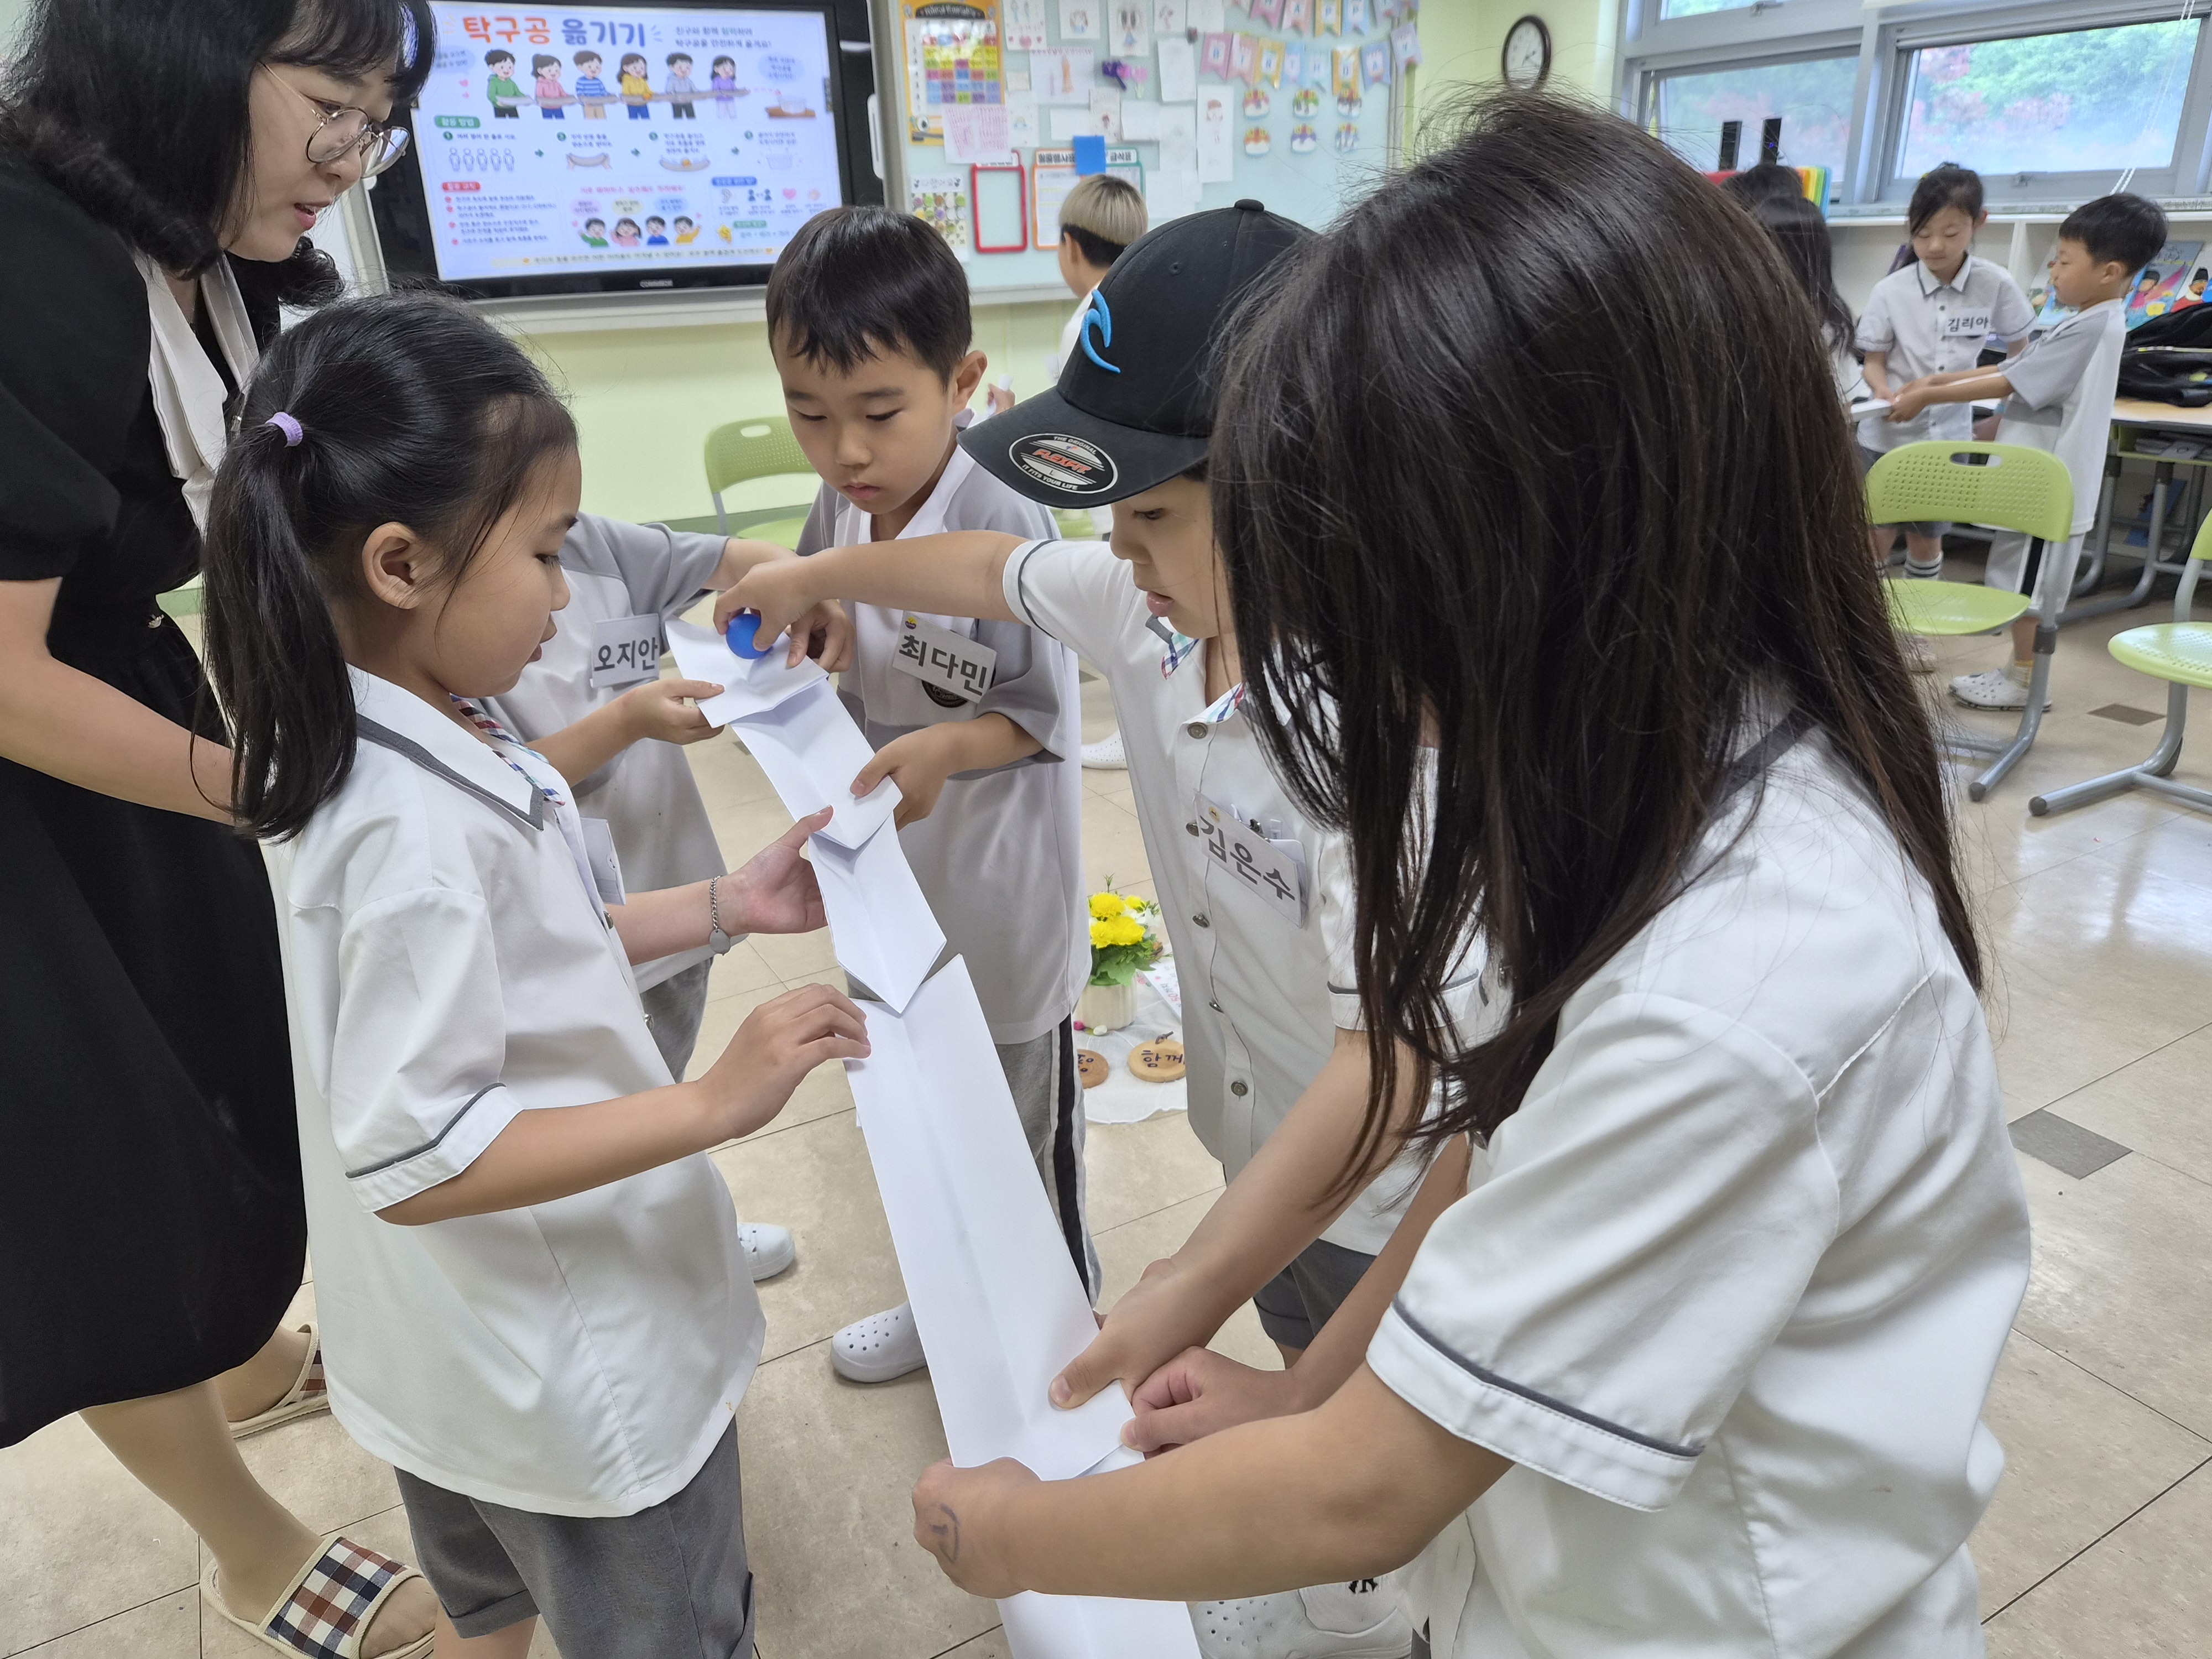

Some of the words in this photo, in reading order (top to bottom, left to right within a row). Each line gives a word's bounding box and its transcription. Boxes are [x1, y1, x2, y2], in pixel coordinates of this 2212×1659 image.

[462, 17, 551, 44] 탁구공
[561, 19, 645, 47] 옮기기
[1948, 316, 1989, 332] 김리아
[1032, 448, 1093, 473] FLEXFIT
[1068, 439, 1097, 455] ORIGINAL
[1027, 468, 1042, 479] FITS
[1042, 476, 1062, 487] YOUR
[594, 637, 658, 672] 오지안
[899, 634, 988, 696] 최다민
[1199, 815, 1296, 901] 김은수
